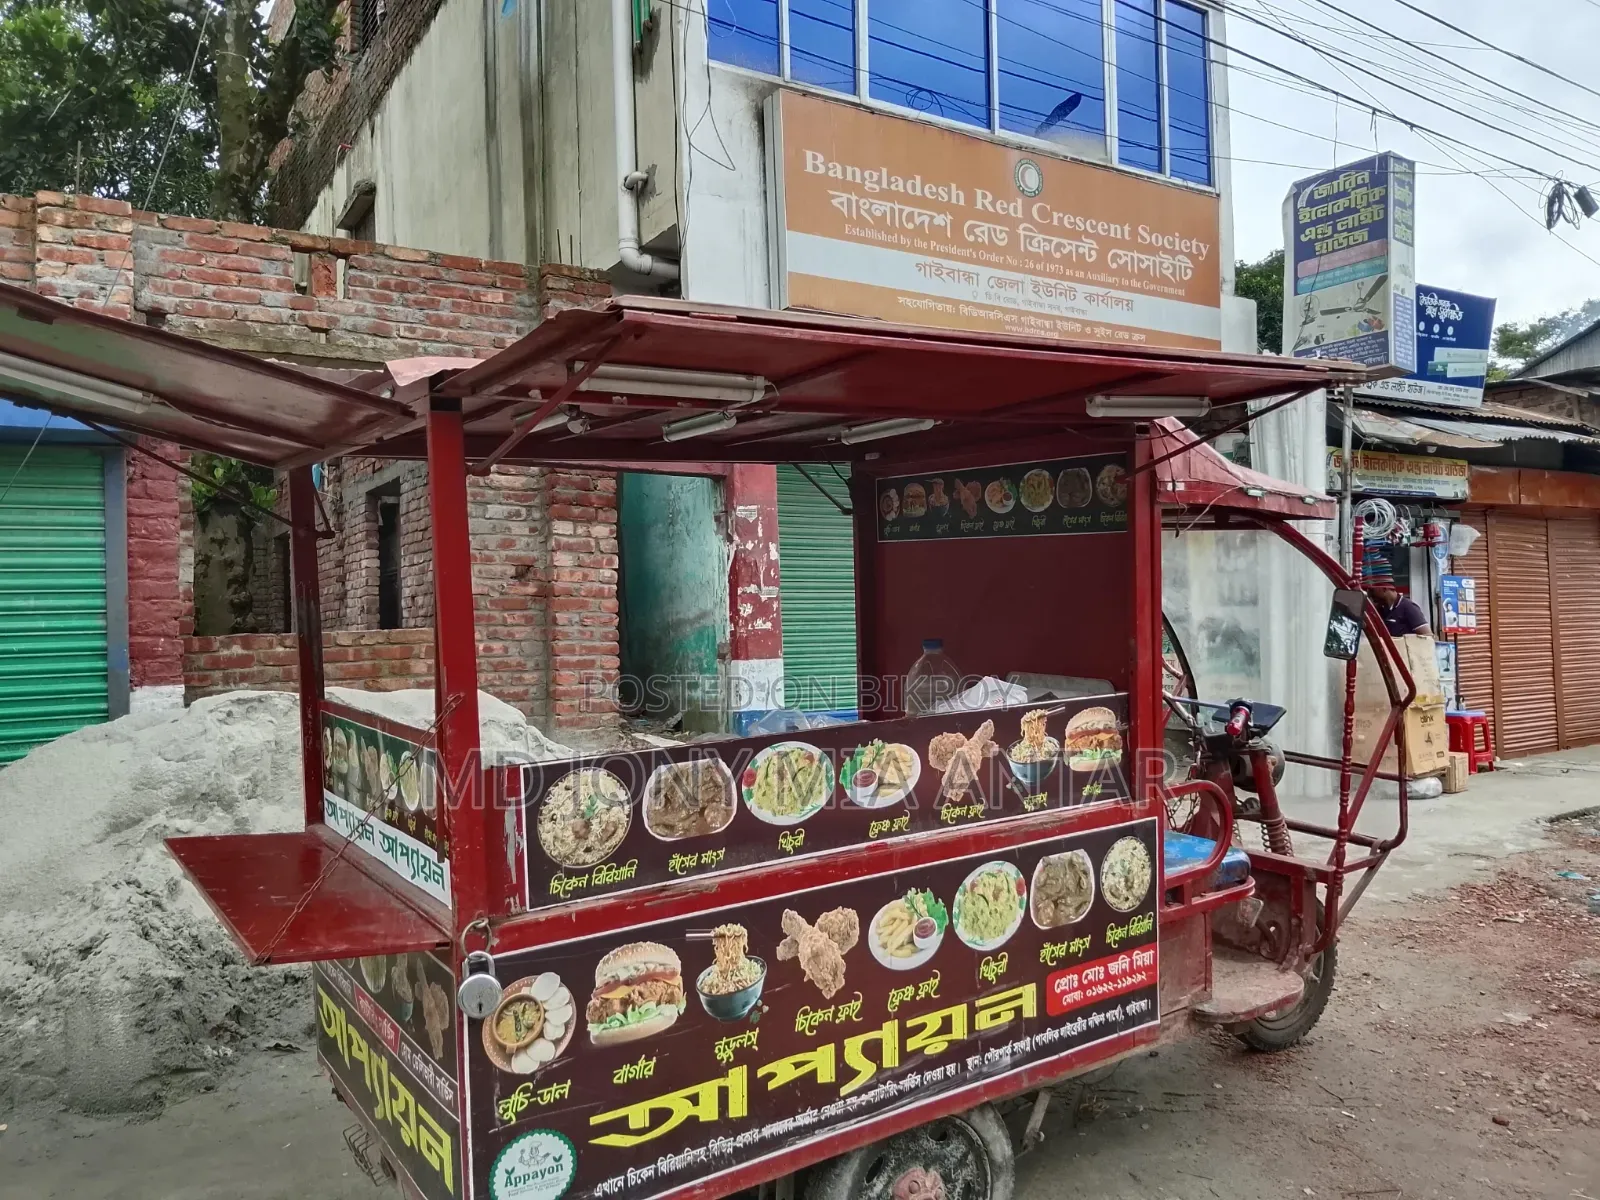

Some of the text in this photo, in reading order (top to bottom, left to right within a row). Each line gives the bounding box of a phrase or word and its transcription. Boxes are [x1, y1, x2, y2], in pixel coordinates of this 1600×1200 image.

[803, 149, 1211, 261] Bangladesh Red Crescent Society
[1298, 185, 1388, 224] ইলেকট্রিক
[1313, 171, 1370, 200] জারিন
[826, 189, 1196, 283] বাংলাদেশ রেড ক্রিসেন্ট সোসাইটি
[1336, 204, 1386, 232] লাইট
[844, 223, 898, 243] Established
[900, 233, 912, 248] by
[914, 237, 928, 250] the
[930, 240, 977, 259] President's
[978, 249, 1004, 264] Order
[1005, 254, 1018, 266] No
[1024, 259, 1034, 269] 26
[1035, 260, 1045, 271] of
[1046, 261, 1064, 275] 1973
[1065, 268, 1074, 277] as
[1075, 270, 1084, 279] an
[1086, 271, 1120, 288] Auxiliary
[1121, 276, 1129, 286] to
[1130, 277, 1142, 289] the
[1143, 279, 1186, 297] Government
[1314, 228, 1370, 256] হাউজ
[915, 260, 1135, 312] গাইবান্ধা জেলা ইউনিট কার্যালয়
[1056, 318, 1082, 333] ইউনিট
[868, 809, 911, 839] ফ্রেঞ্চ ফ্রাই
[940, 797, 986, 824] চিকেন ফ্রাই
[379, 830, 446, 892] আপ্যায়ন
[550, 858, 639, 898] চিকেন বিরিয়ানি
[667, 846, 726, 875] হাঁসের মাংস
[1105, 911, 1154, 949] চিকেন বিরিয়ানি
[1039, 934, 1091, 966] হাঁসের মাংস
[887, 969, 941, 1012] ফ্রেঞ্চ ফ্রাই
[1054, 949, 1155, 994] প্রোঃ মোঃ জনি মিয়া
[795, 991, 864, 1036] চিকেন ফ্রাই
[588, 983, 1037, 1147] আপ্যায়ন
[613, 1054, 657, 1086] বার্গার
[317, 982, 454, 1196] আপ্যায়ন
[435, 1075, 454, 1109] সার্ভিস
[498, 1079, 572, 1125] লুচি-ডাল
[594, 1174, 625, 1198] এখানে
[627, 1163, 655, 1188] চিকেন
[708, 1136, 734, 1158] বিভিন্ন
[735, 1128, 759, 1149] প্রকার
[899, 1071, 921, 1092] সার্ভিস
[923, 1066, 944, 1085] দেওয়া
[1013, 1037, 1032, 1056] সংলগ্ন
[1032, 1028, 1060, 1051] (পাবলিক
[504, 1162, 564, 1188] Appayon
